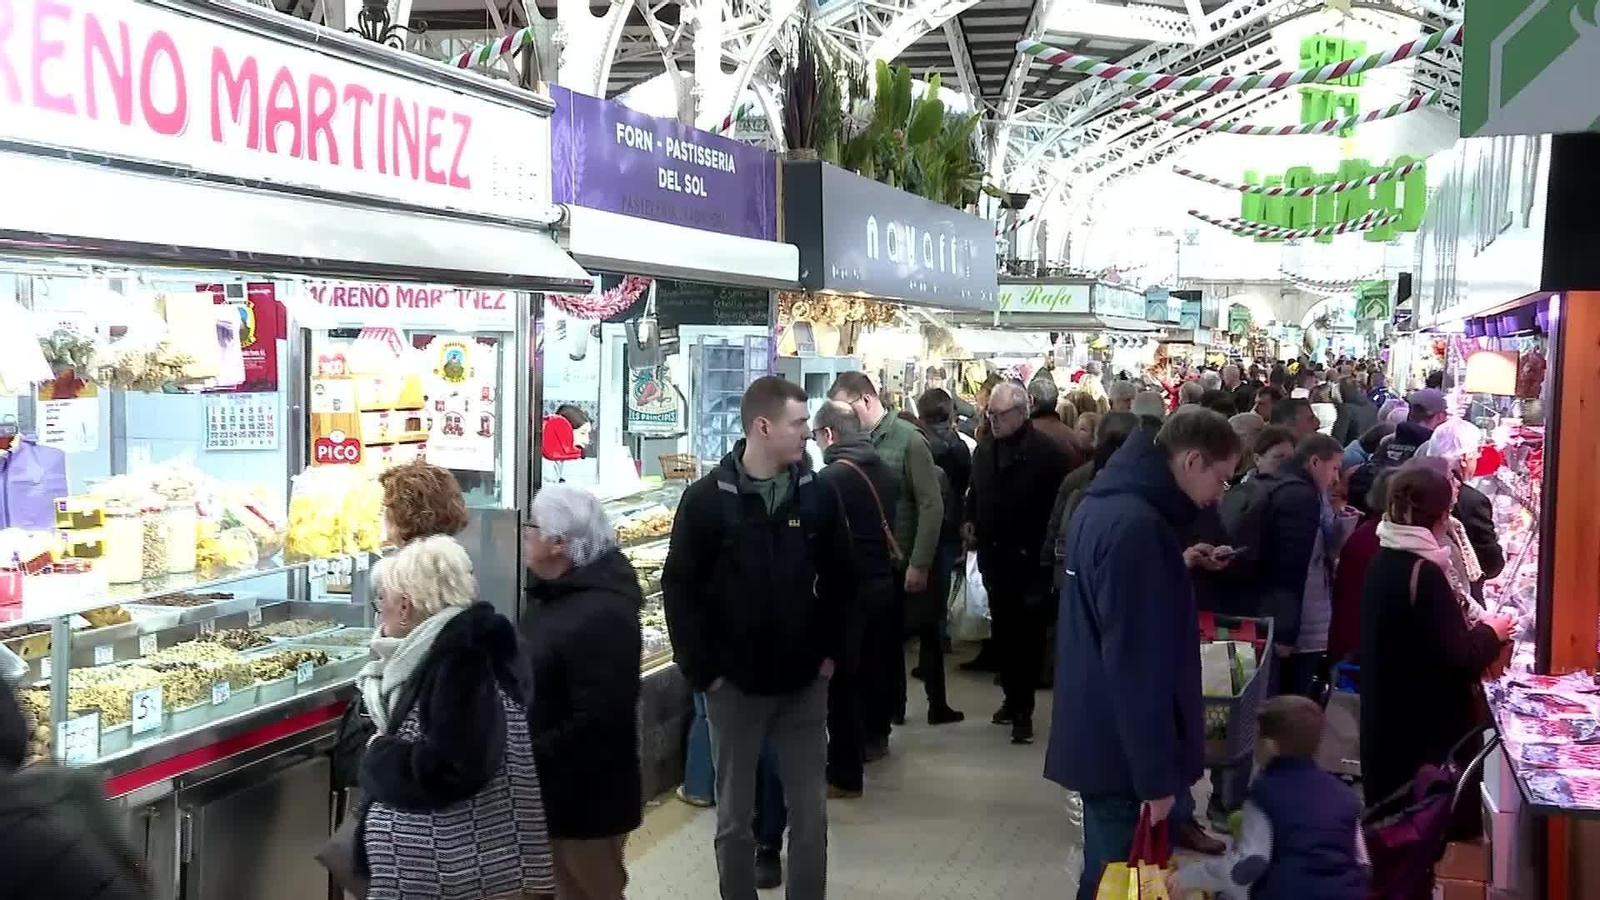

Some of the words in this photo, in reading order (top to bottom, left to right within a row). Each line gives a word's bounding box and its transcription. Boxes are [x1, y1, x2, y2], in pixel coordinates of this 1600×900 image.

[210, 46, 472, 190] MARTINEZ
[616, 122, 653, 153] FORN
[666, 137, 736, 174] PASTISSERIA
[658, 167, 682, 192] DEL
[684, 174, 708, 197] SOL
[1021, 286, 1073, 313] Rafa
[317, 445, 358, 460] PICO
